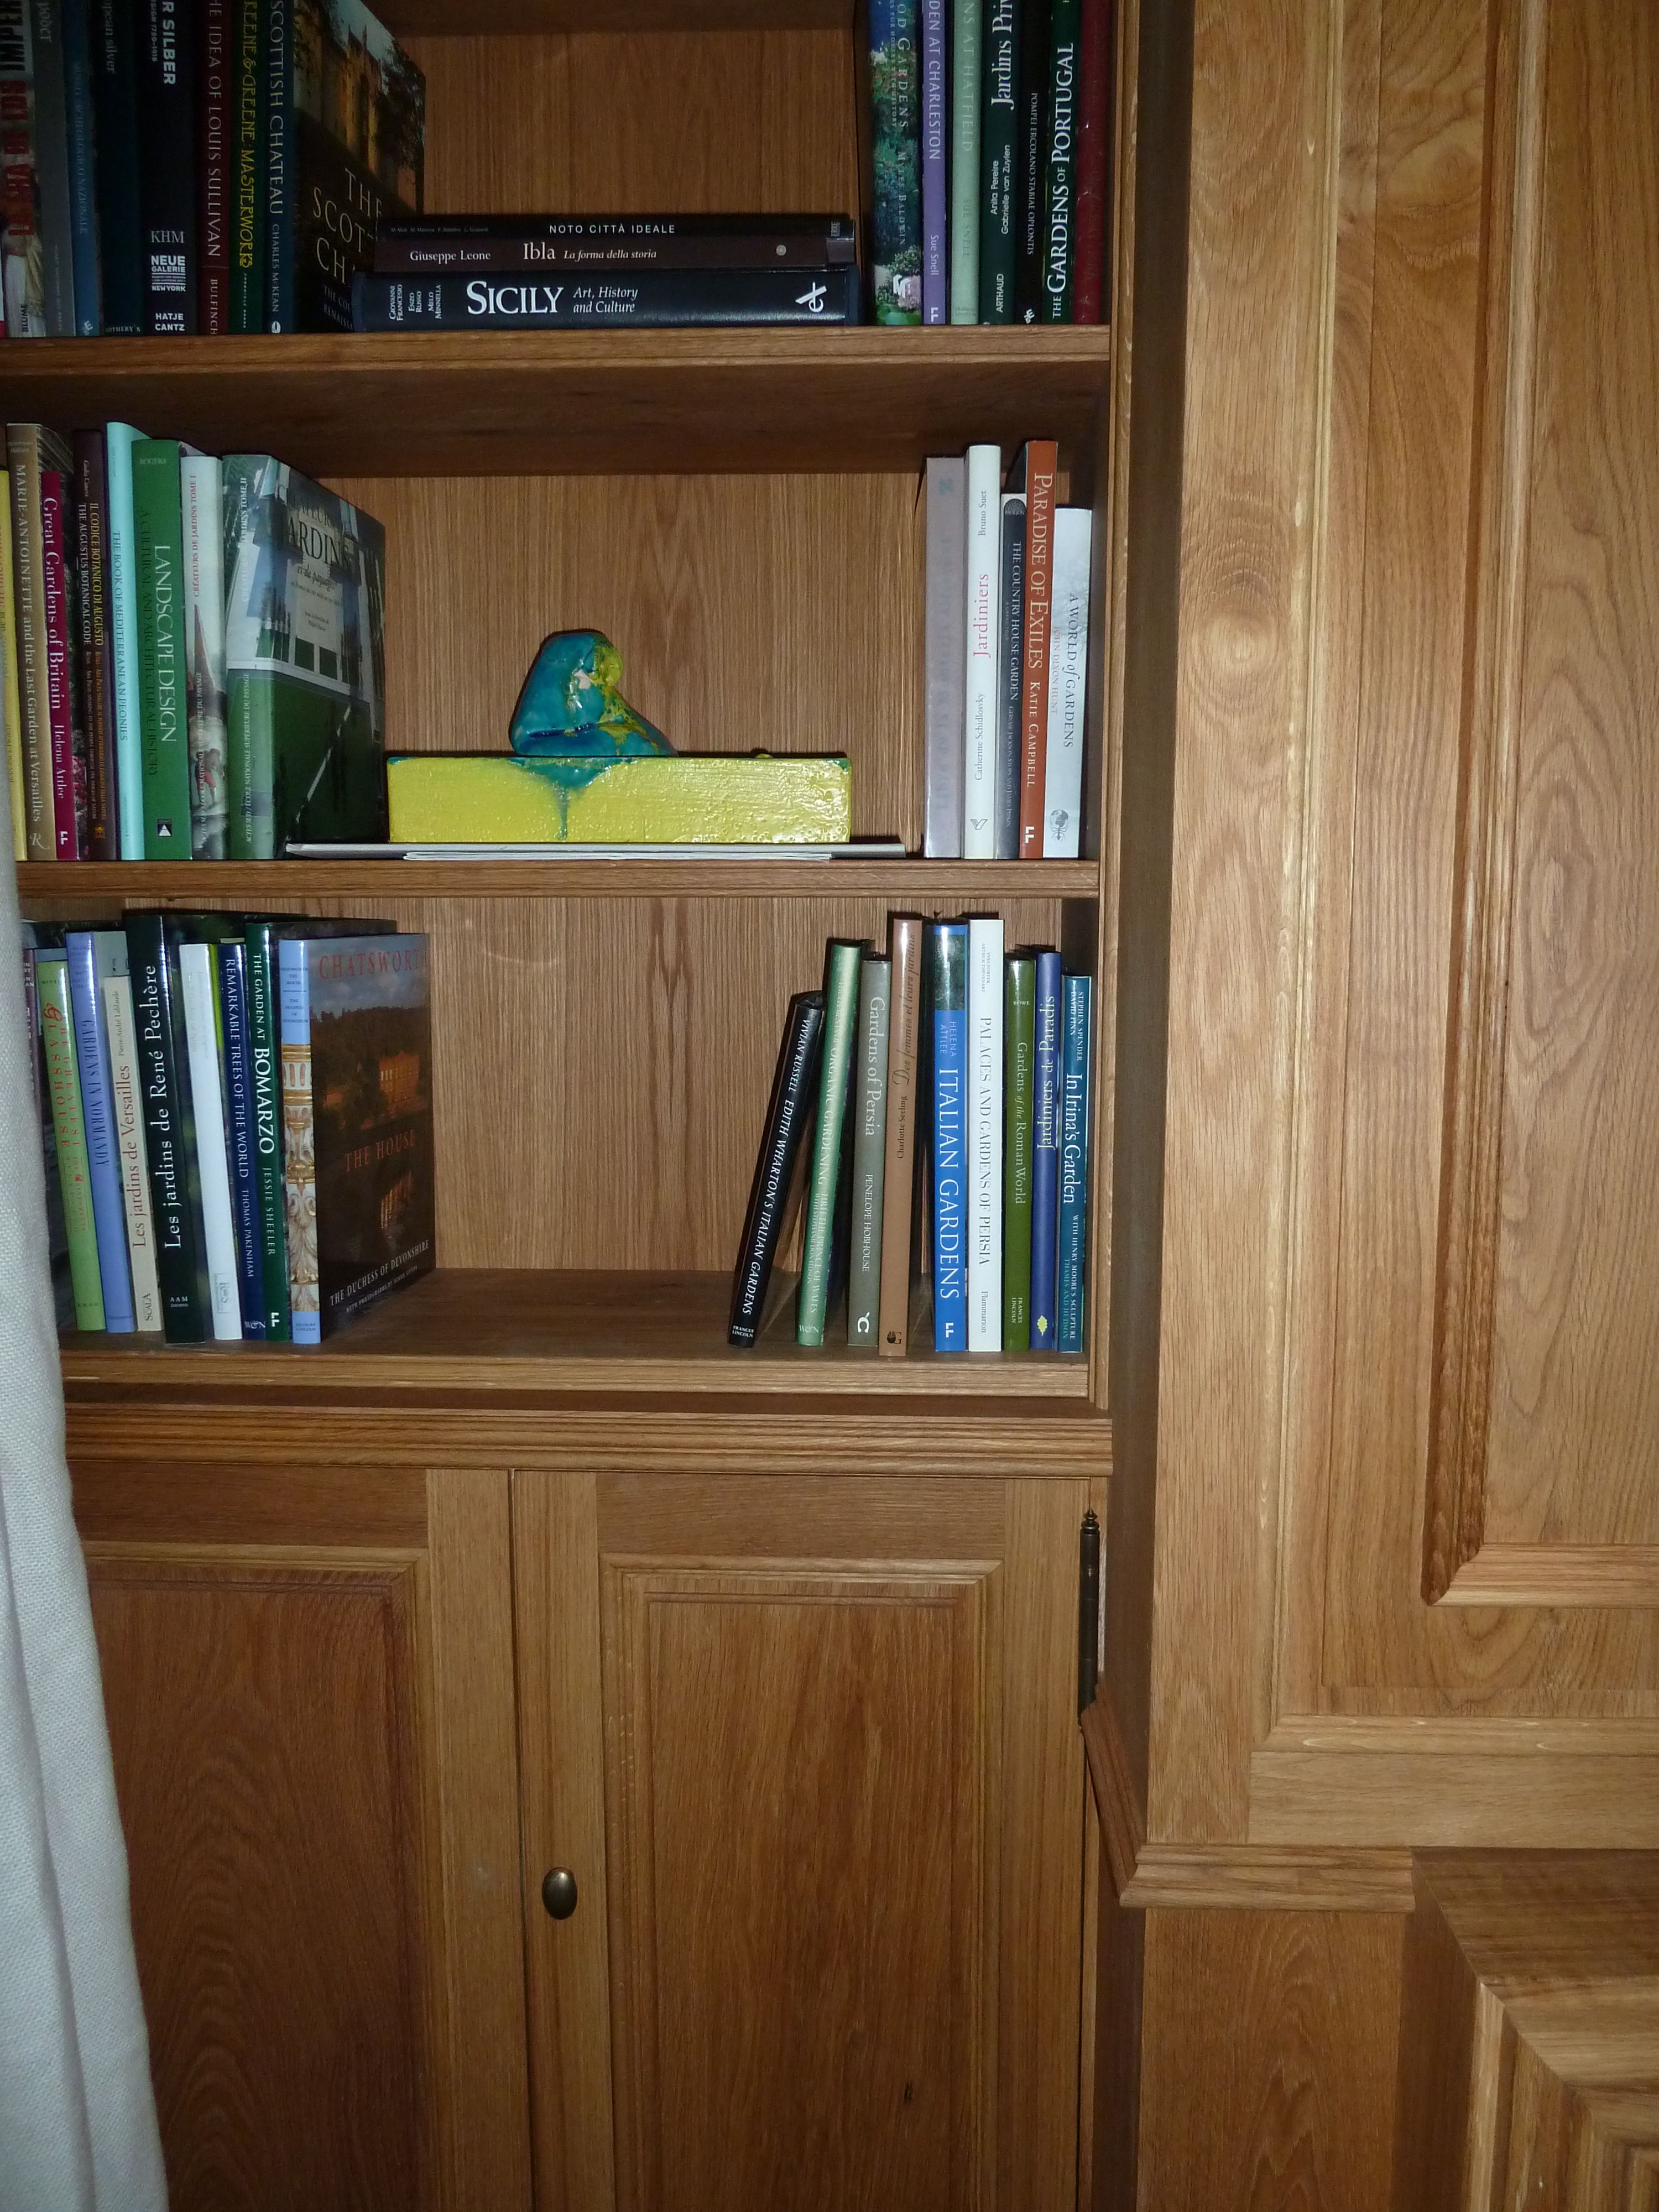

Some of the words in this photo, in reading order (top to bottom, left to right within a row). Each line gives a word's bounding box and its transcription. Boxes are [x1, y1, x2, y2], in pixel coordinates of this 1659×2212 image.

[163, 19, 177, 85] SILBER
[208, 26, 222, 69] IDEA
[963, 33, 974, 56] AT
[208, 76, 222, 99] OF
[990, 40, 1015, 111] Jardins
[928, 60, 941, 160] CHARLESTON
[962, 66, 973, 152] HATFIELD
[1030, 92, 1039, 125] POMPEI
[1051, 43, 1074, 165] PORTUGAL
[269, 115, 284, 215] CHATEAU
[1002, 144, 1011, 174] Zuylen
[1028, 127, 1038, 175] ERCOLANO
[1027, 176, 1036, 210] STABIAE
[1056, 166, 1066, 182] OF
[79, 178, 88, 235] NAZIONALE
[207, 168, 222, 257] SULLIVAN
[238, 148, 255, 269] MASTERWORKS
[990, 191, 999, 216] Anita
[1001, 194, 1010, 235] Gabrielle
[150, 229, 186, 244] KHM
[272, 224, 280, 269] CHARLES
[549, 225, 583, 234] NOTO
[632, 224, 677, 234] IDEALE
[930, 235, 940, 251] Sue
[1026, 212, 1036, 256] OPLONTIS
[1046, 185, 1070, 294] GARDENS
[151, 254, 186, 267] NEUE
[409, 250, 457, 265] Giuseppe
[460, 250, 492, 262] Leone
[522, 241, 556, 261] Ibla
[562, 250, 577, 260] La
[606, 248, 629, 259] della
[930, 254, 940, 276] Snell
[210, 279, 218, 336] BULFINCH
[466, 280, 565, 315] SICILY
[573, 300, 593, 314] and
[595, 300, 637, 314] Culture
[597, 286, 639, 302] History
[996, 273, 1004, 314] ARTHAUD
[1052, 296, 1062, 319] THE
[21, 303, 32, 332] BLUME
[155, 312, 185, 321] HATJE
[155, 323, 186, 332] CANTZ
[43, 497, 59, 544] Great
[78, 502, 88, 521] THE
[90, 512, 101, 546] CODICE
[191, 505, 199, 538] JARDINS
[978, 512, 987, 536] Bruno
[1031, 473, 1053, 565] PARADISE
[16, 465, 33, 613] MARIE-ANTOINETTE
[79, 523, 90, 568] AUGUSTUS
[113, 530, 121, 552] THE
[191, 541, 199, 551] DE
[1013, 541, 1022, 564] THE
[45, 551, 62, 623] Gardens
[91, 547, 103, 592] BOTANICO
[113, 554, 123, 585] BOOK
[1030, 570, 1046, 597] OF
[81, 570, 92, 619] BOTANICAL
[114, 587, 123, 602] OF
[154, 545, 175, 665] LANDSCAPE
[1011, 565, 1022, 614] COUNTRY
[82, 620, 92, 645] CODE
[93, 606, 104, 646] AUGUSTO
[973, 573, 991, 658] Jardiniers
[1028, 600, 1048, 669] EXILES
[1066, 607, 1079, 661] WORLD
[24, 644, 35, 665] the
[47, 628, 64, 646] of
[115, 604, 126, 696] MEDITERRANEAN
[1010, 619, 1021, 656] HOUSE
[1052, 625, 1062, 651] JOHN
[48, 651, 65, 709] Britain
[1009, 658, 1020, 701] GARDEN
[1052, 654, 1061, 685] DIXON
[1062, 664, 1081, 680] of
[158, 669, 178, 742] DESIGN
[1029, 681, 1040, 717] KATIE
[1051, 686, 1060, 714] HUNT
[1063, 680, 1076, 748] GARDENS
[27, 697, 39, 744] Garden
[118, 698, 128, 742] PEONIES
[54, 724, 66, 763] Helena
[974, 742, 984, 780] Catherine
[1026, 724, 1039, 788] CAMPBELL
[30, 761, 44, 822] Versailles
[252, 953, 262, 975] THE
[138, 965, 162, 1041] Pechère
[225, 958, 241, 1040] REMARKABLE
[254, 978, 265, 1024] GARDEN
[1076, 991, 1084, 1025] STEPHEN
[257, 1026, 265, 1040] AT
[796, 1018, 810, 1054] VIVIAN
[868, 996, 885, 1063] Gardens
[940, 1024, 949, 1054] ATTLEE
[949, 1021, 957, 1057] HELENA
[1039, 996, 1055, 1052] Paradis
[230, 1044, 242, 1079] TREES
[979, 1017, 992, 1082] PALACES
[1016, 1041, 1029, 1092] Gardens
[148, 1050, 168, 1099] René
[233, 1083, 244, 1099] OF
[788, 1055, 803, 1092] RUSSELL
[867, 1066, 883, 1084] of
[1065, 1073, 1083, 1089] In
[114, 1065, 136, 1136] Versailles
[234, 1102, 246, 1128] THE
[253, 1047, 275, 1154] BOMARZO
[779, 1099, 795, 1137] EDITH
[865, 1088, 882, 1136] Persia
[938, 1067, 959, 1168] ITALIAN
[979, 1086, 992, 1116] AND
[1015, 1095, 1025, 1104] of
[1016, 1105, 1025, 1119] the
[1036, 1080, 1056, 1151] Jardiniers
[90, 1100, 111, 1166] NORMANDY
[149, 1108, 170, 1131] de
[122, 1142, 138, 1160] de
[236, 1131, 249, 1178] WORLD
[979, 1120, 992, 1188] GARDENS
[1016, 1121, 1027, 1166] Roman
[154, 1141, 182, 1207] jardins
[262, 1167, 273, 1201] JESSIE
[1015, 1166, 1026, 1204] World
[1063, 1144, 1082, 1204] Garden
[241, 1188, 252, 1227] THOMAS
[863, 1173, 874, 1220] PENELOPE
[979, 1192, 992, 1211] OF
[132, 1223, 147, 1248] Les
[164, 1215, 181, 1249] Les
[265, 1207, 276, 1256] SHEELER
[753, 1211, 772, 1260] ITALIAN
[862, 1221, 872, 1272] HOBHOUSE
[939, 1178, 959, 1300] GARDENS
[978, 1216, 991, 1265] PERSIA
[1071, 1237, 1079, 1262] HENRY
[347, 1269, 379, 1296] DUCHESS
[380, 1264, 389, 1277] OF
[391, 1238, 430, 1270] DEVONSHIRE
[742, 1261, 761, 1315] GARDENS
[732, 1324, 754, 1334] FRANCES
[980, 1290, 989, 1333] Flammarion
[732, 1329, 754, 1338] LINCOLN
